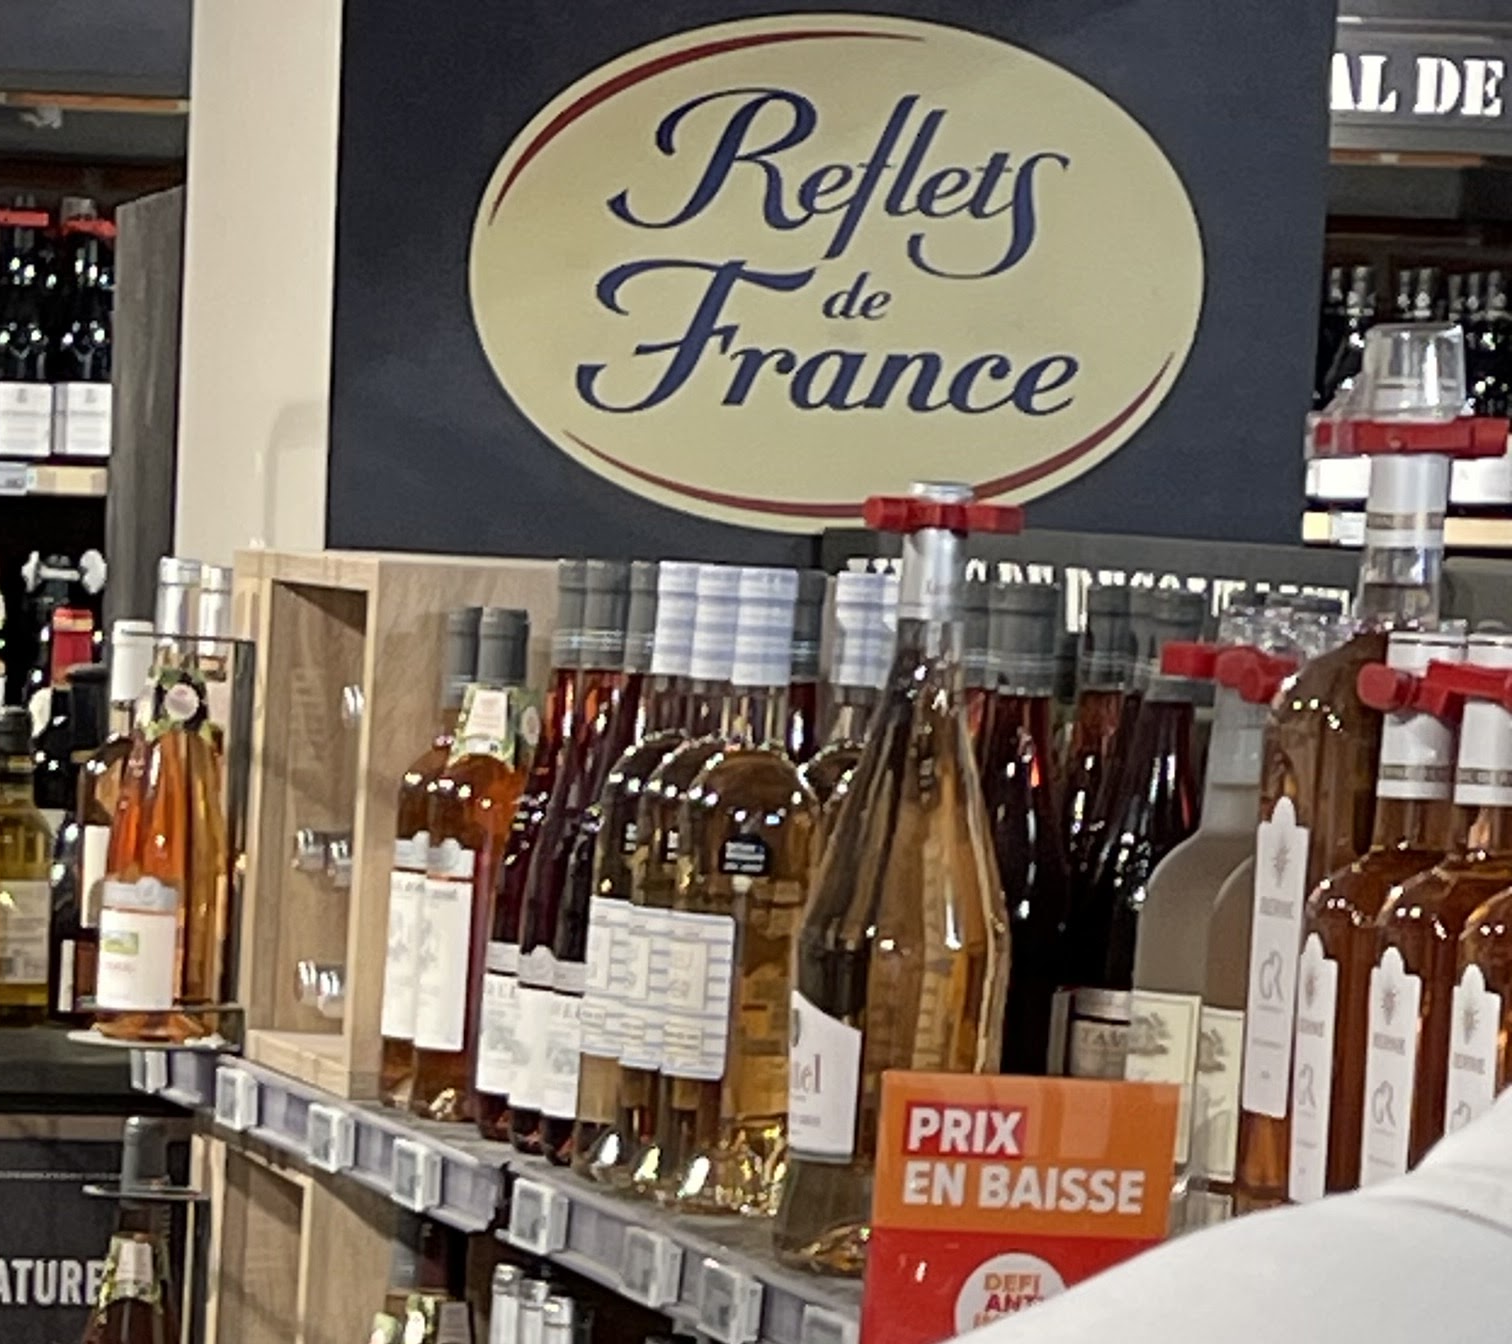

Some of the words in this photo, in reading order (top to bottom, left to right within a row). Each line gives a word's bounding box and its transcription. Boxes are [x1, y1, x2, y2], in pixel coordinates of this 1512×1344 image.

[1412, 56, 1505, 117] DE
[607, 87, 1070, 279] Reflets
[822, 271, 892, 321] de
[575, 259, 1080, 417] France
[907, 1106, 1023, 1155] PRIX
[904, 1161, 967, 1206] EN
[978, 1165, 1146, 1215] BAISSE
